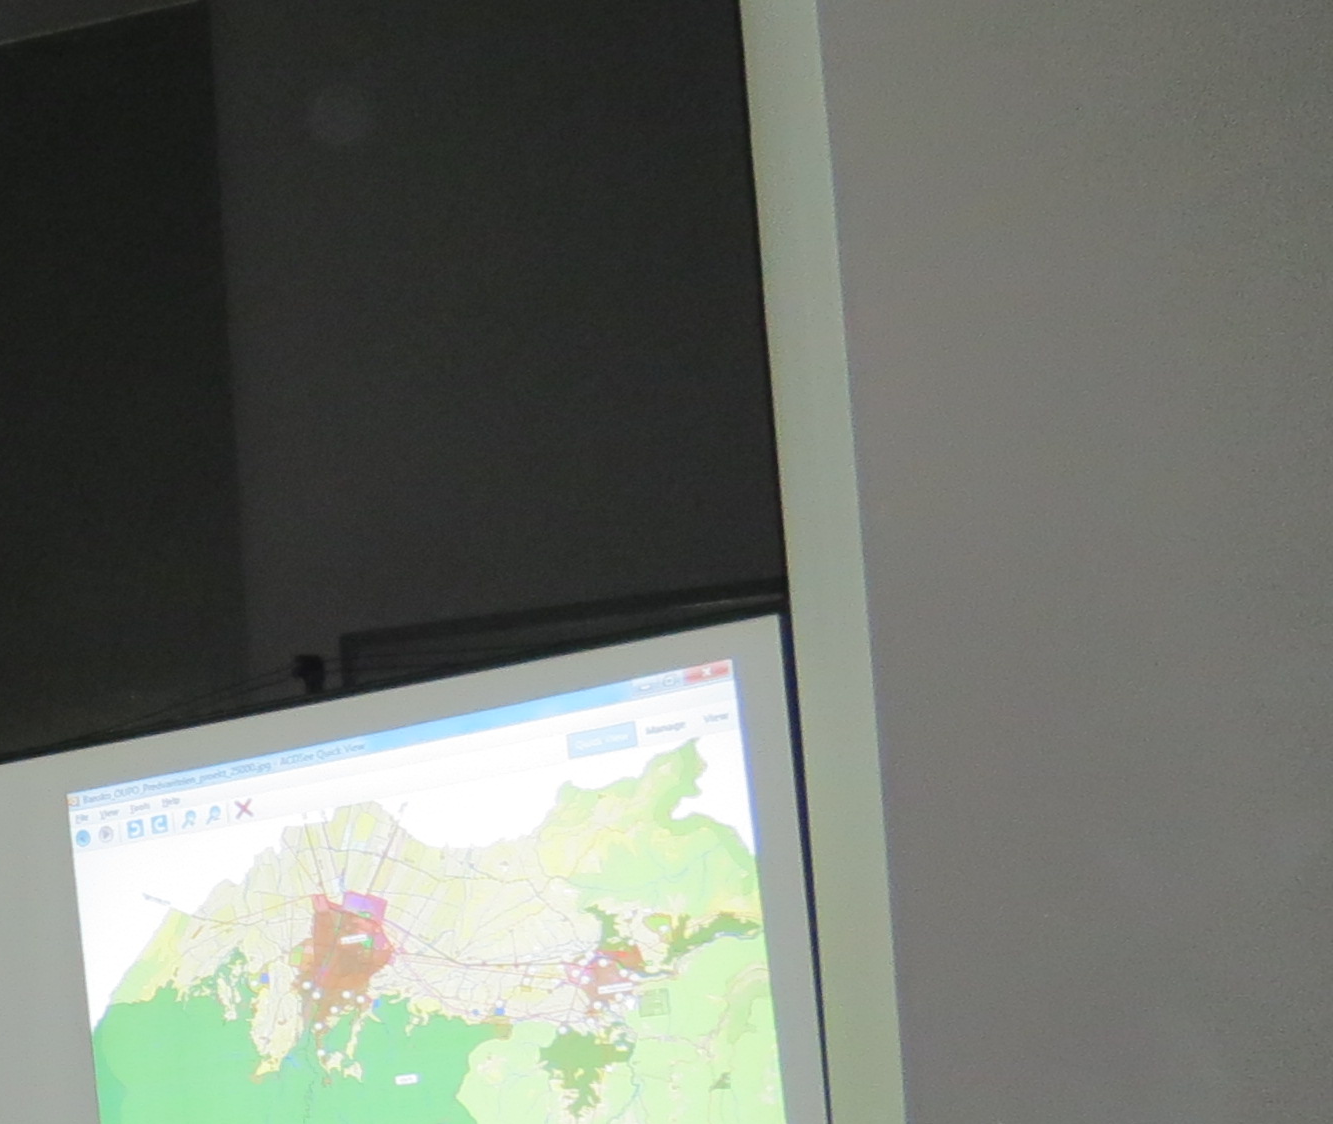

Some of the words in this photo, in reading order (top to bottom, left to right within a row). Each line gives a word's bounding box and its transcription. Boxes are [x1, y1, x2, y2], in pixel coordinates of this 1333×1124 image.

[702, 712, 729, 724] View
[645, 720, 687, 736] Manage
[317, 746, 341, 763] Quick
[343, 742, 366, 757] View
[100, 807, 118, 820] View
[162, 796, 180, 809] Help
